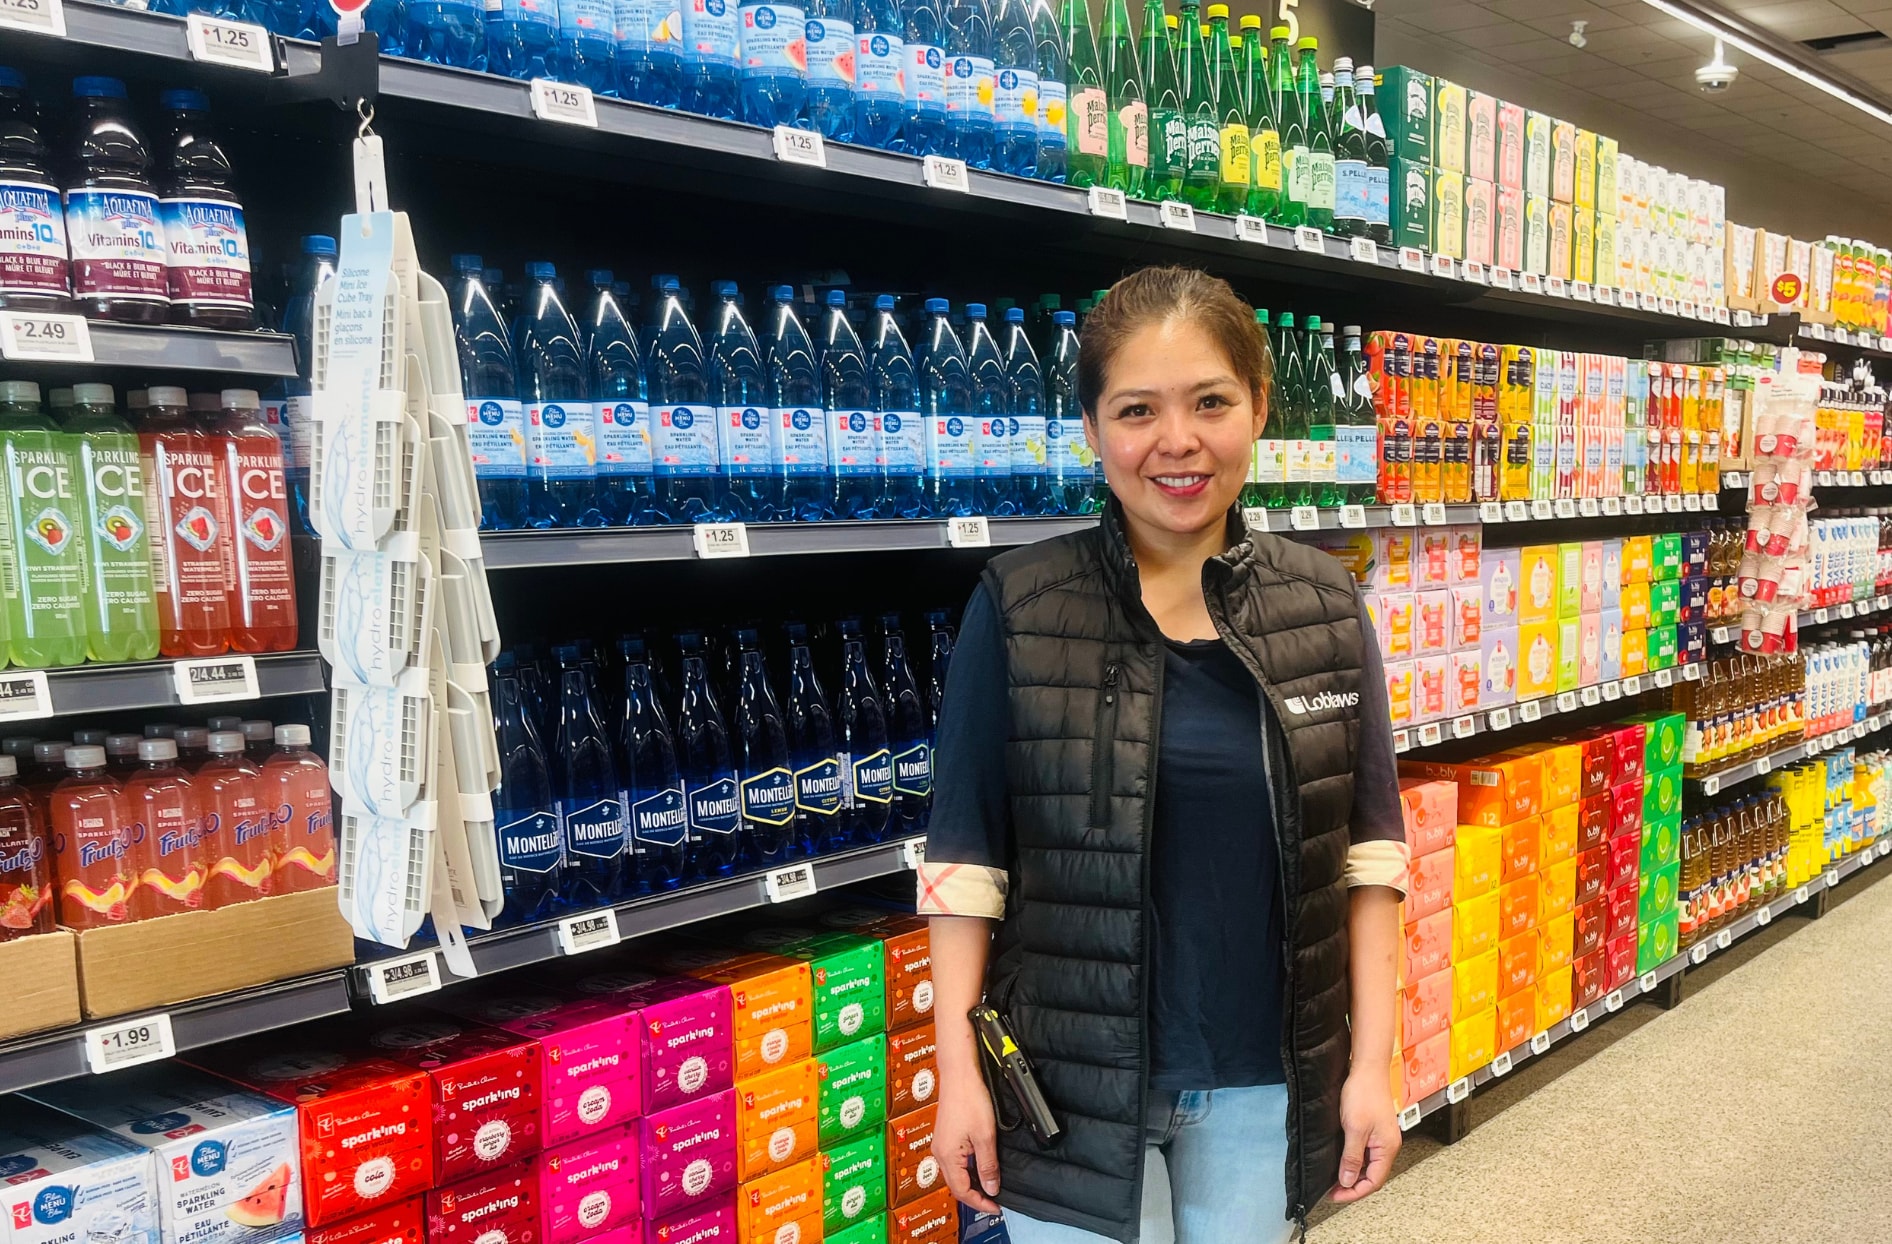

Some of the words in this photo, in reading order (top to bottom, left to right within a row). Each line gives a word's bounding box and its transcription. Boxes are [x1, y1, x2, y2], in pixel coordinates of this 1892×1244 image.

[212, 27, 249, 48] 1.25
[552, 90, 579, 106] 1.25
[790, 136, 812, 149] 1.25
[939, 163, 957, 176] 1.25
[102, 195, 154, 223] AQUAFINA
[186, 205, 236, 231] AQUAFINA
[105, 262, 124, 270] BLACK
[189, 269, 207, 277] BLACK
[338, 293, 356, 303] Cube
[1777, 280, 1796, 298] $5
[24, 322, 65, 339] 2.49
[16, 466, 72, 499] ICE
[94, 465, 145, 497] CE
[166, 467, 217, 498] ICE
[241, 469, 286, 499] CE
[712, 530, 734, 542] 1.25
[962, 523, 979, 534] 1.25
[190, 667, 226, 682] 2/4.44
[1301, 691, 1359, 711] Loblaws
[1483, 813, 1496, 825] 12
[390, 964, 413, 980] 3/4.98
[830, 976, 870, 997] sparkling
[112, 1028, 149, 1048] 1.99
[667, 1026, 714, 1048] sparkling
[567, 1054, 619, 1077] sparkling
[832, 1068, 872, 1090] sparkling
[463, 1087, 520, 1111] sparkling
[760, 1097, 802, 1120] sparkling
[341, 1122, 406, 1149] sparkling
[673, 1128, 719, 1152] sparkling
[197, 1151, 220, 1164] MENU
[365, 1170, 384, 1183] cola
[567, 1159, 619, 1184] sparkling
[834, 1158, 872, 1180] sparkling
[177, 1188, 225, 1209] SPARKLING
[181, 1182, 220, 1198] WATERMELON
[40, 1198, 66, 1212] MENU
[186, 1200, 215, 1215] WATER
[461, 1195, 518, 1222] sparkling
[180, 1220, 230, 1244] PÉTILLANTE
[194, 1219, 212, 1230] EAU
